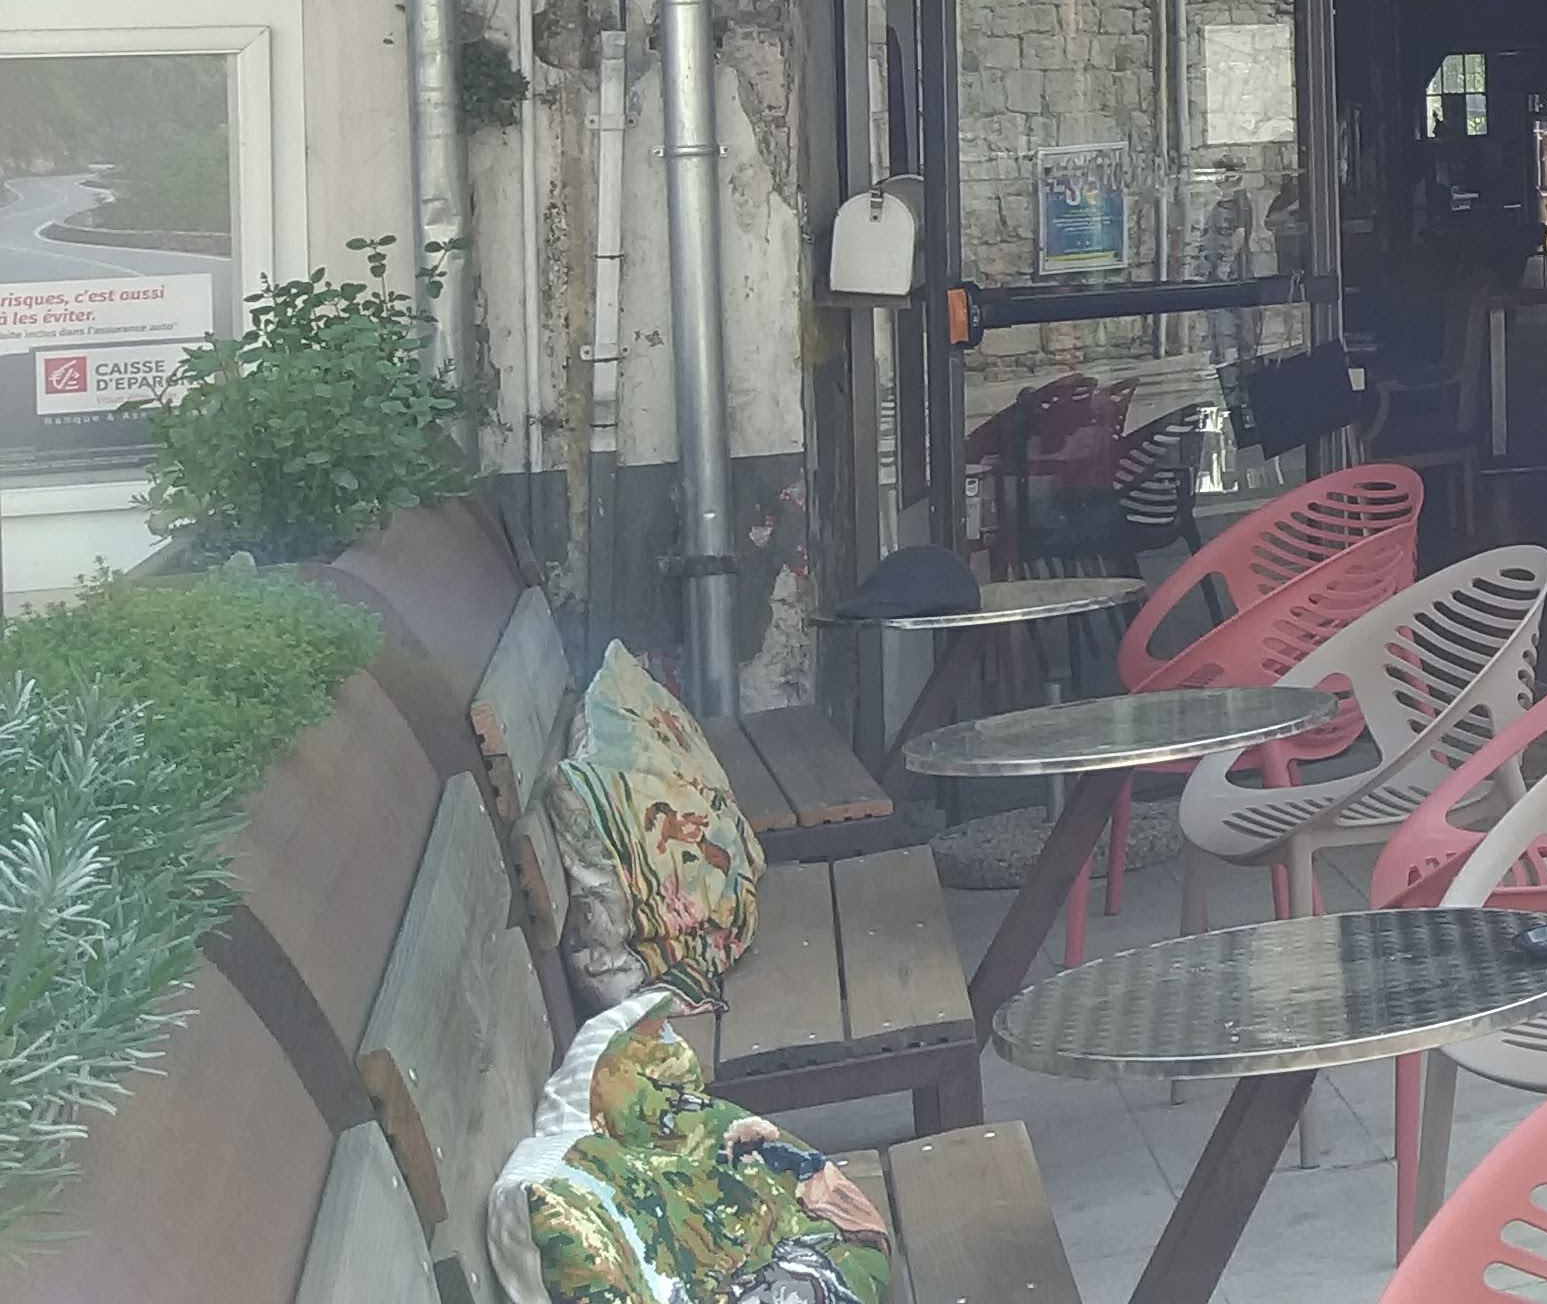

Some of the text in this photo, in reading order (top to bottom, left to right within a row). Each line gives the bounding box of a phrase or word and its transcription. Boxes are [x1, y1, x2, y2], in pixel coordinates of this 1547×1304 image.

[74, 289, 115, 305] c'est
[120, 284, 166, 300] aussi
[13, 310, 38, 326] les
[43, 308, 97, 324] éviter.
[95, 360, 166, 377] CAISSE
